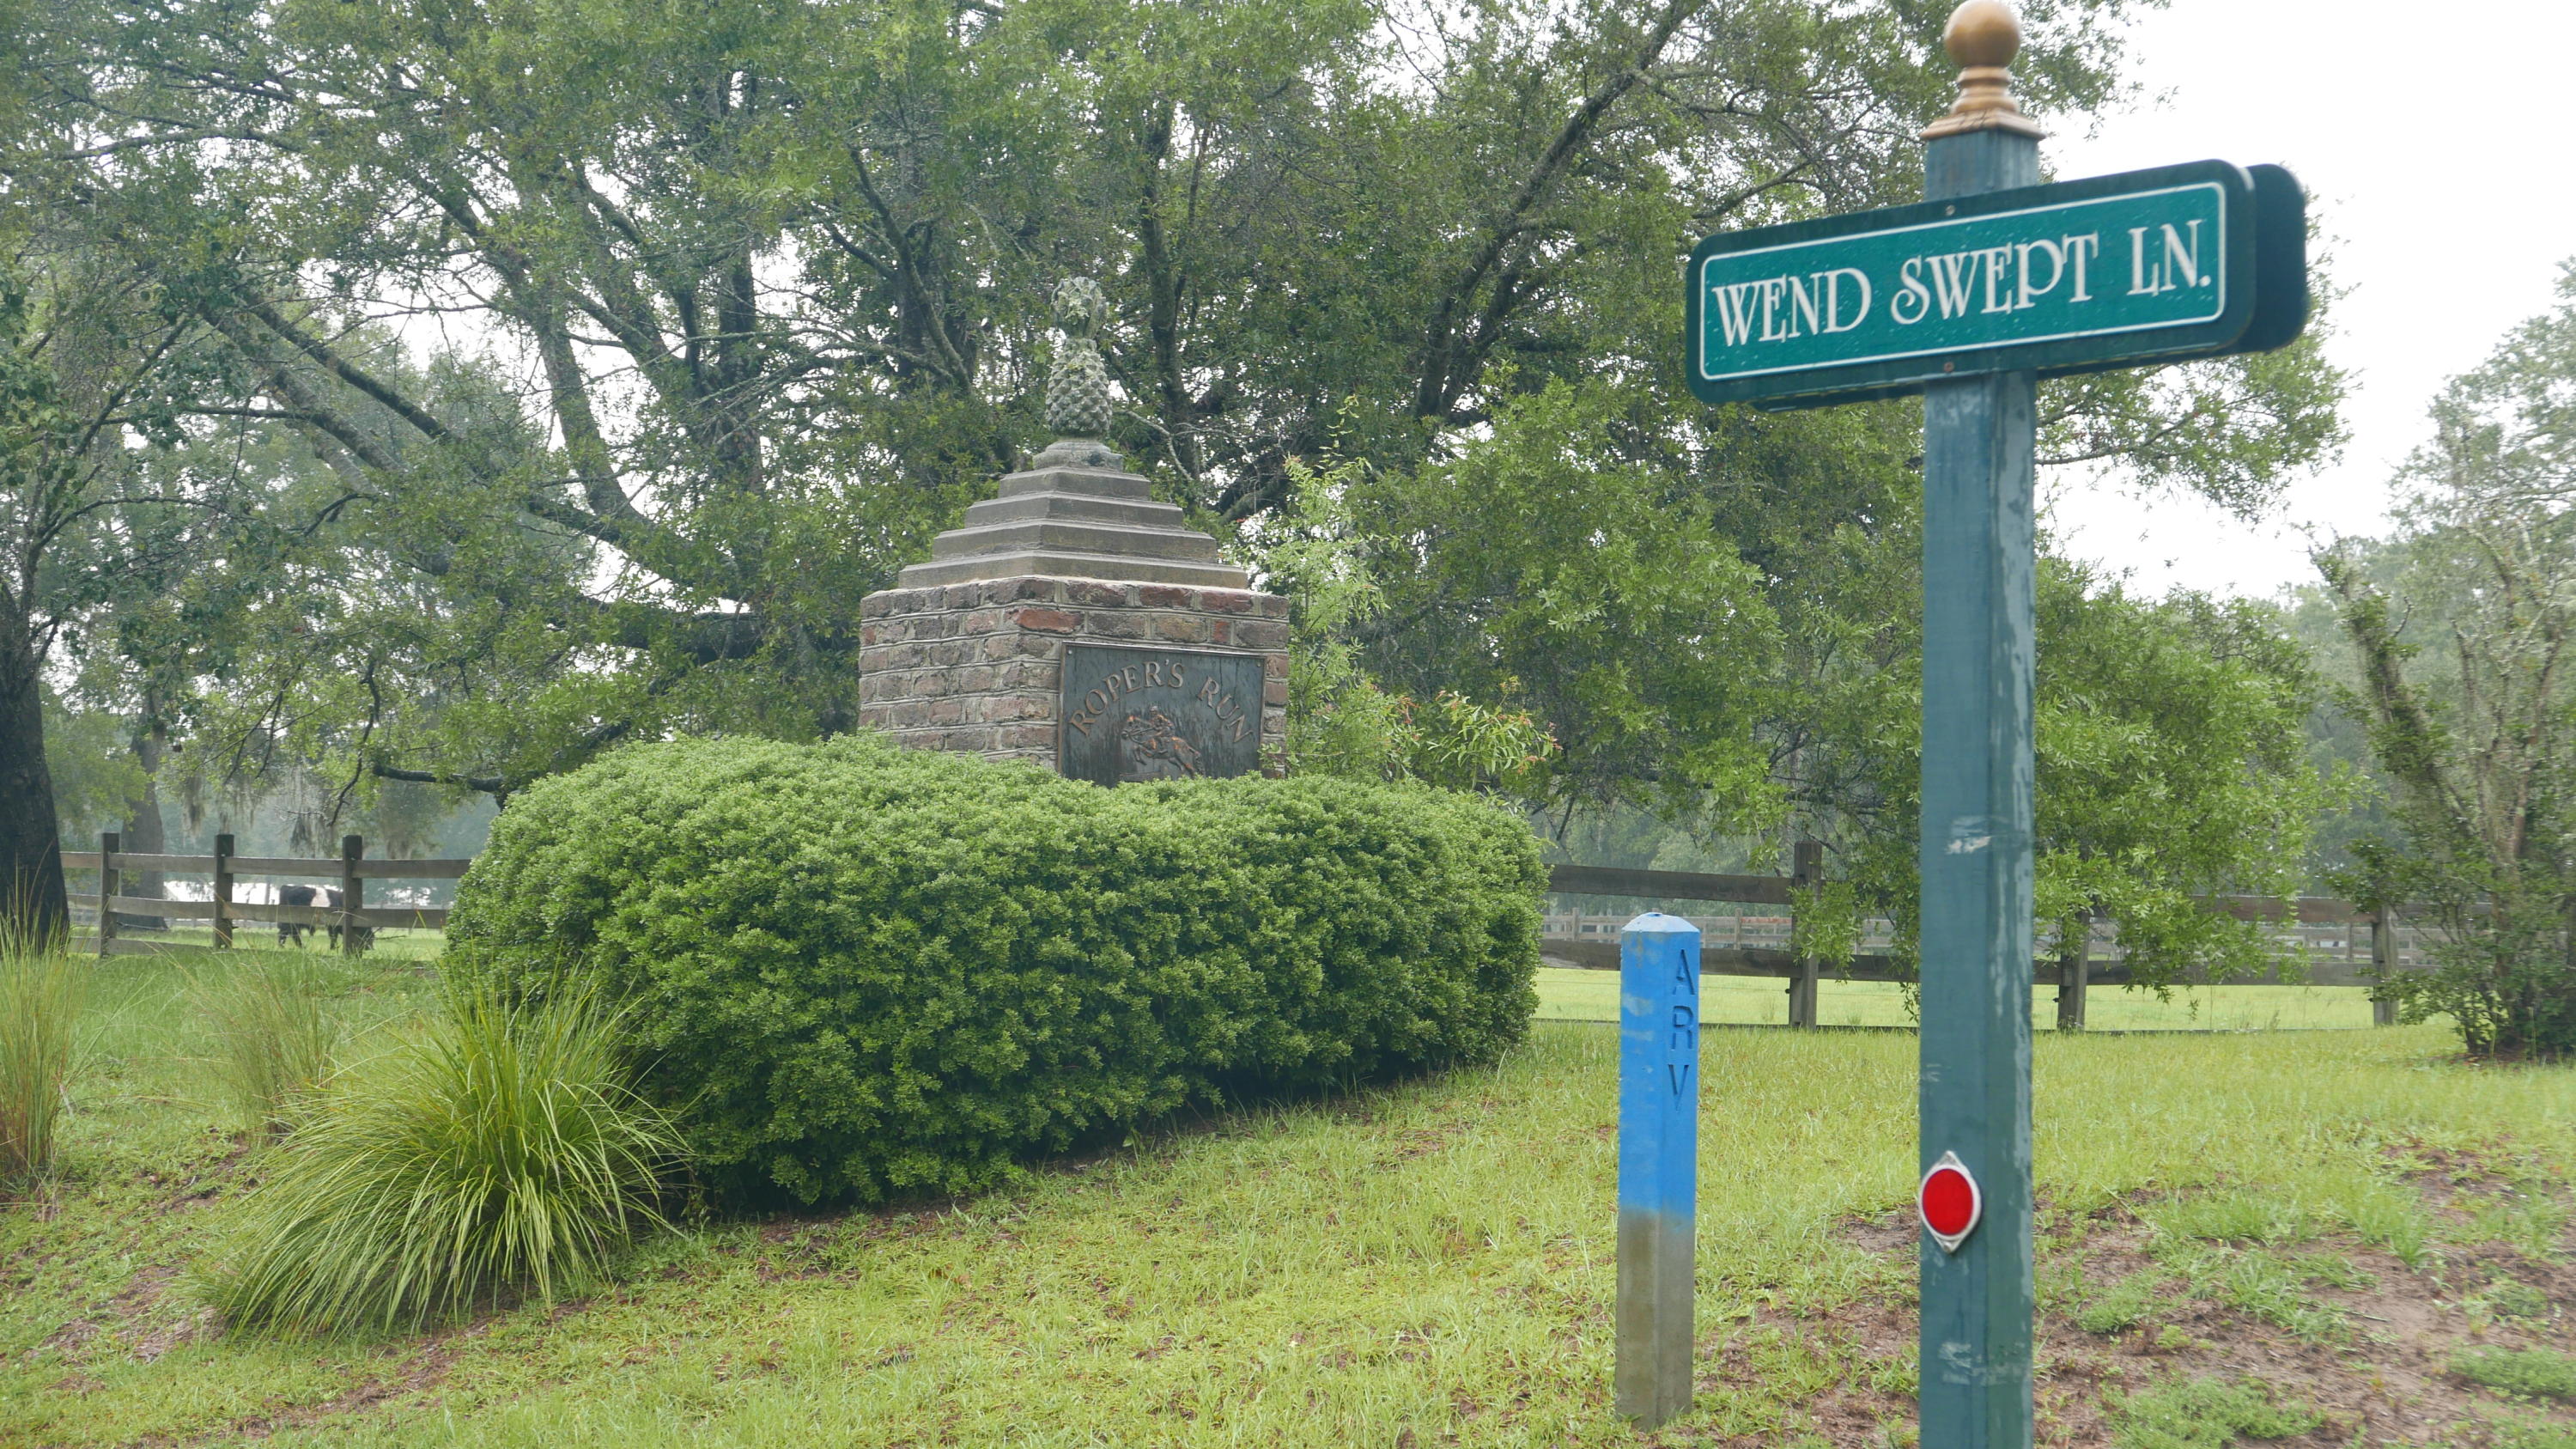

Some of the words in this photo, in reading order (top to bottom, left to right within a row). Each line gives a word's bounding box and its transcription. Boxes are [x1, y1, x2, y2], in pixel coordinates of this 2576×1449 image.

[1711, 268, 1873, 347] WEND
[1890, 230, 2099, 325] SWEPT
[2128, 219, 2212, 297] LN.
[1067, 659, 1186, 737] ROPER'S
[1197, 675, 1254, 744] RUN
